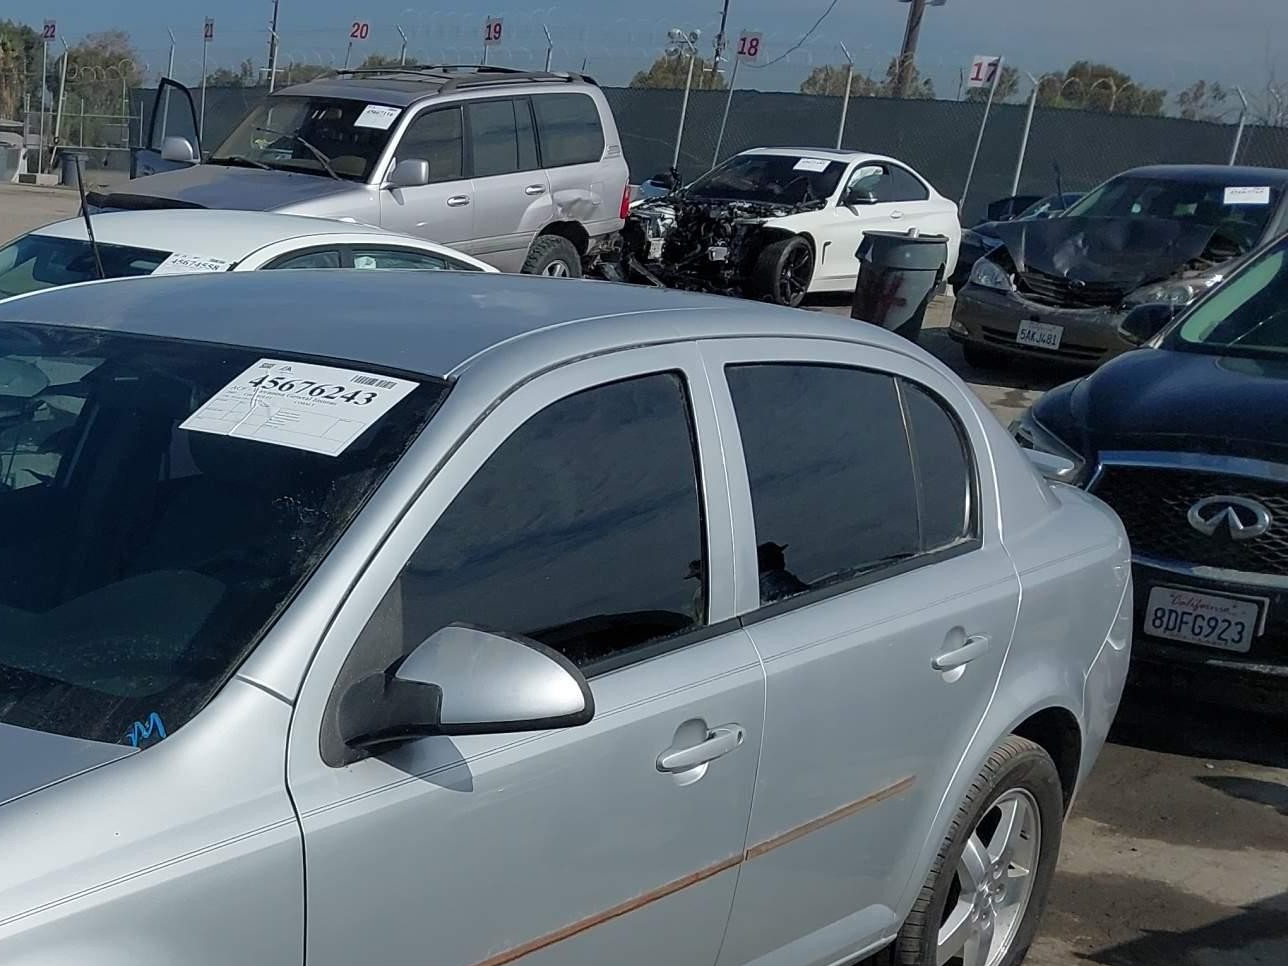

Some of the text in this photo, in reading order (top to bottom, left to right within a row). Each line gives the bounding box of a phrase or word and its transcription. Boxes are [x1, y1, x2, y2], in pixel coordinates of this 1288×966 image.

[43, 24, 56, 39] 22
[350, 22, 369, 39] 20
[485, 23, 502, 40] 19
[737, 37, 759, 56] 18
[971, 62, 999, 82] 17
[248, 374, 378, 406] 45676243
[1152, 607, 1246, 644] 8DFG923
